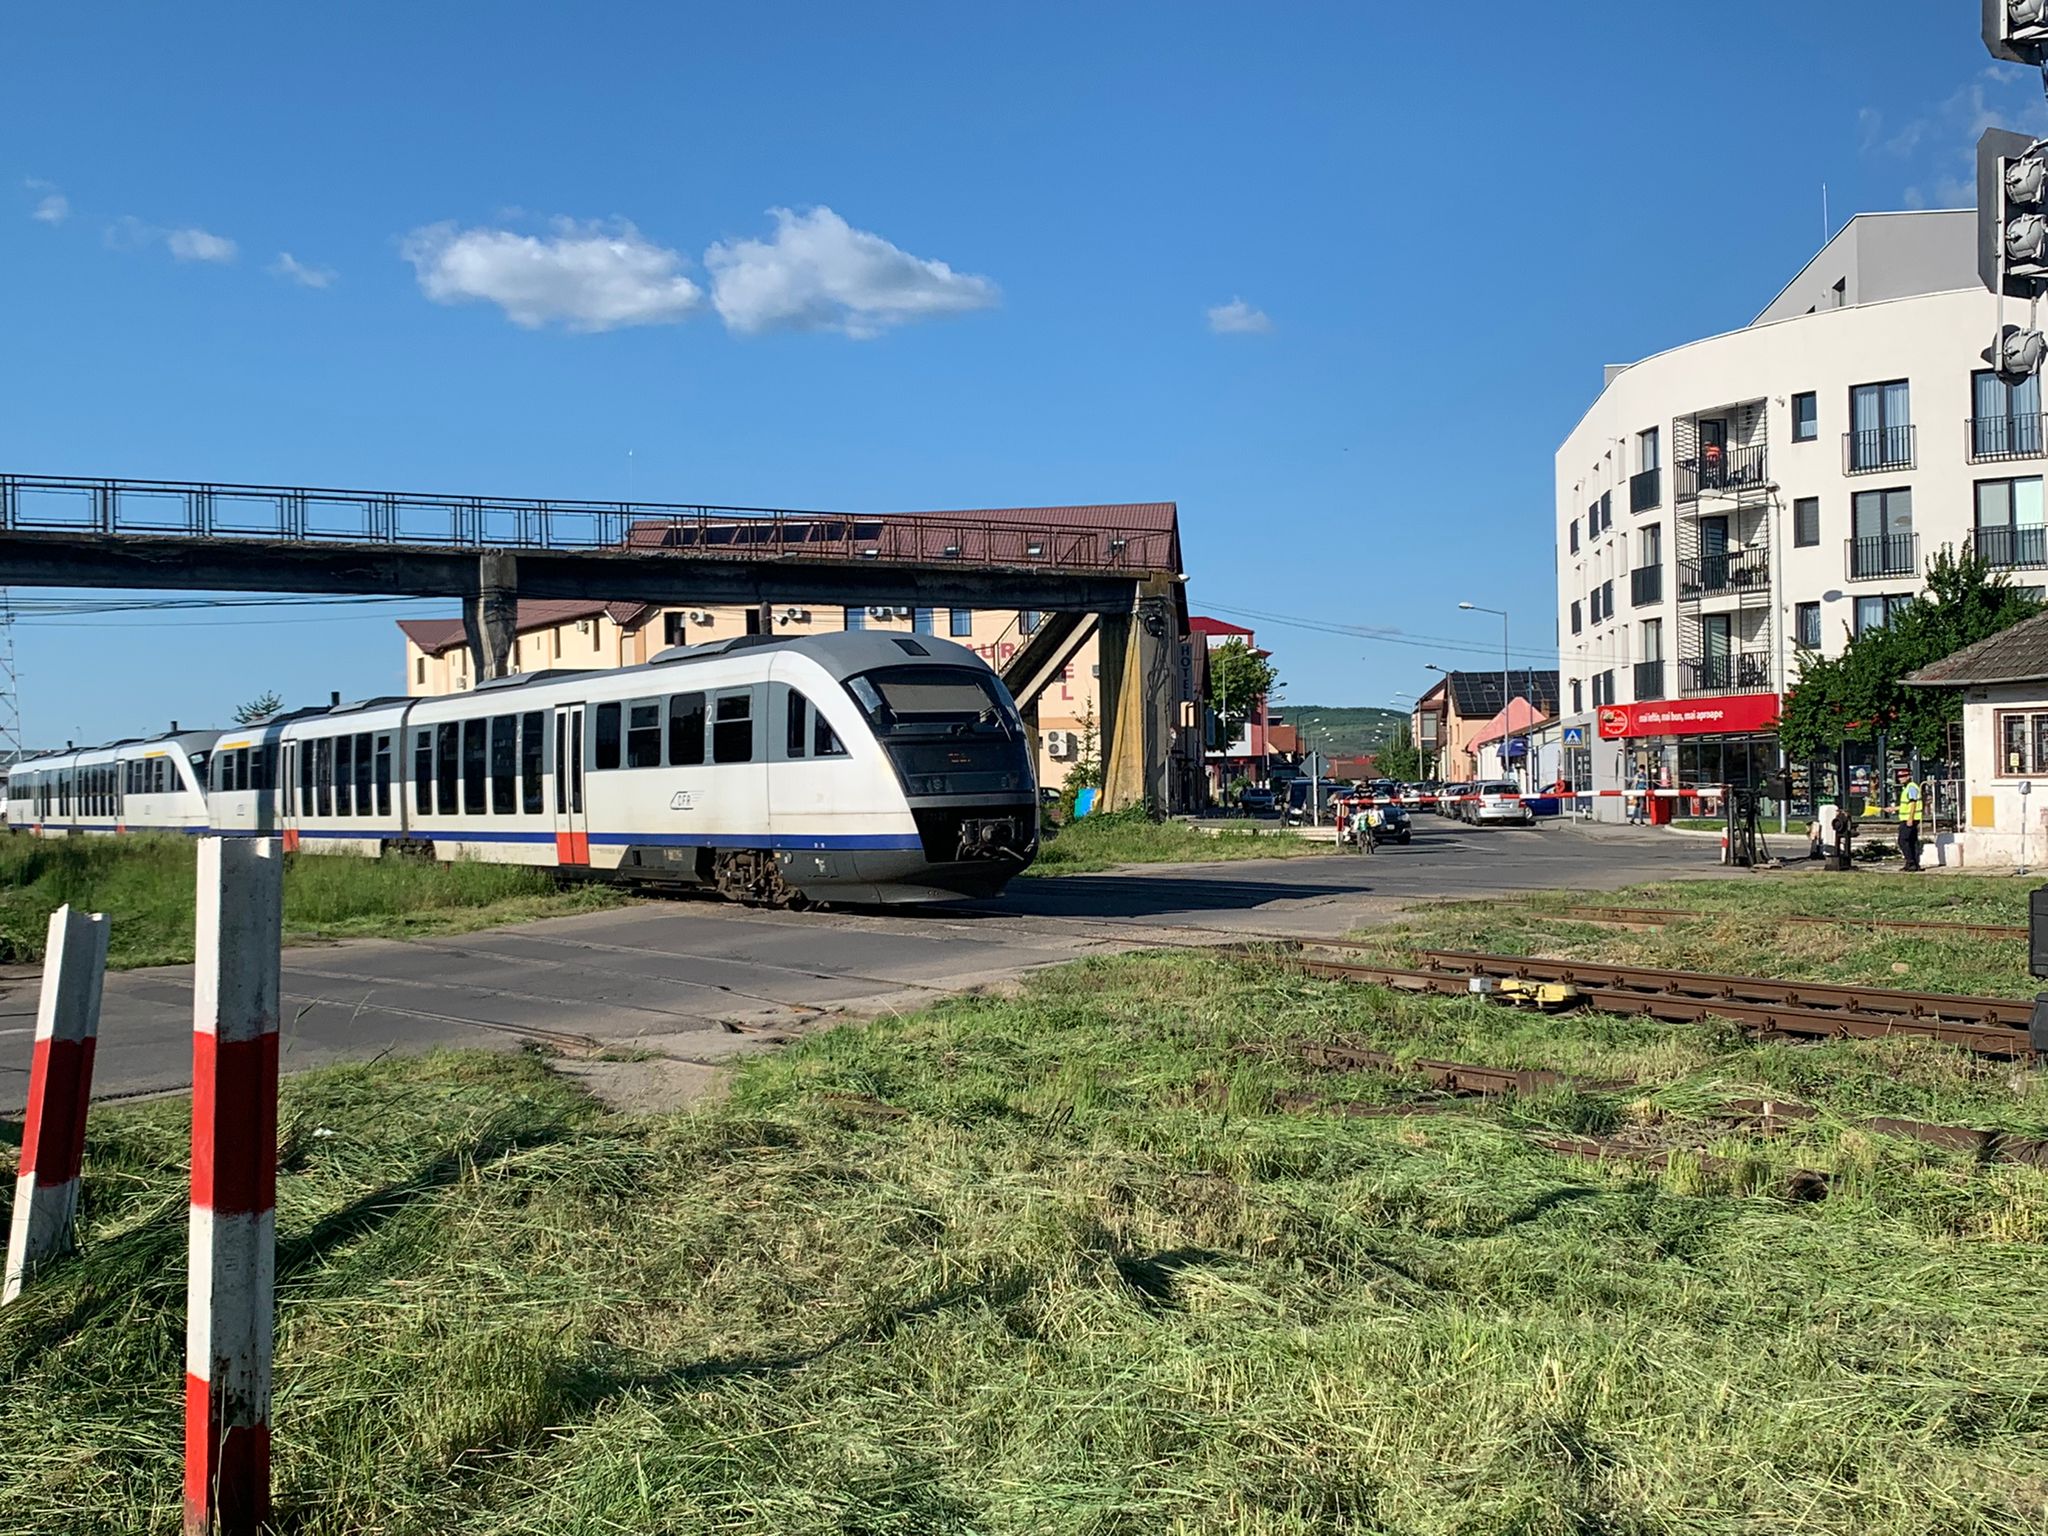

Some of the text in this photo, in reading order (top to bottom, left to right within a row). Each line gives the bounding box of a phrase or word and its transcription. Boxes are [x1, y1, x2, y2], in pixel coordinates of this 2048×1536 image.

[1180, 645, 1191, 700] HOTEL
[706, 704, 713, 725] 2
[1696, 710, 1724, 722] aproape
